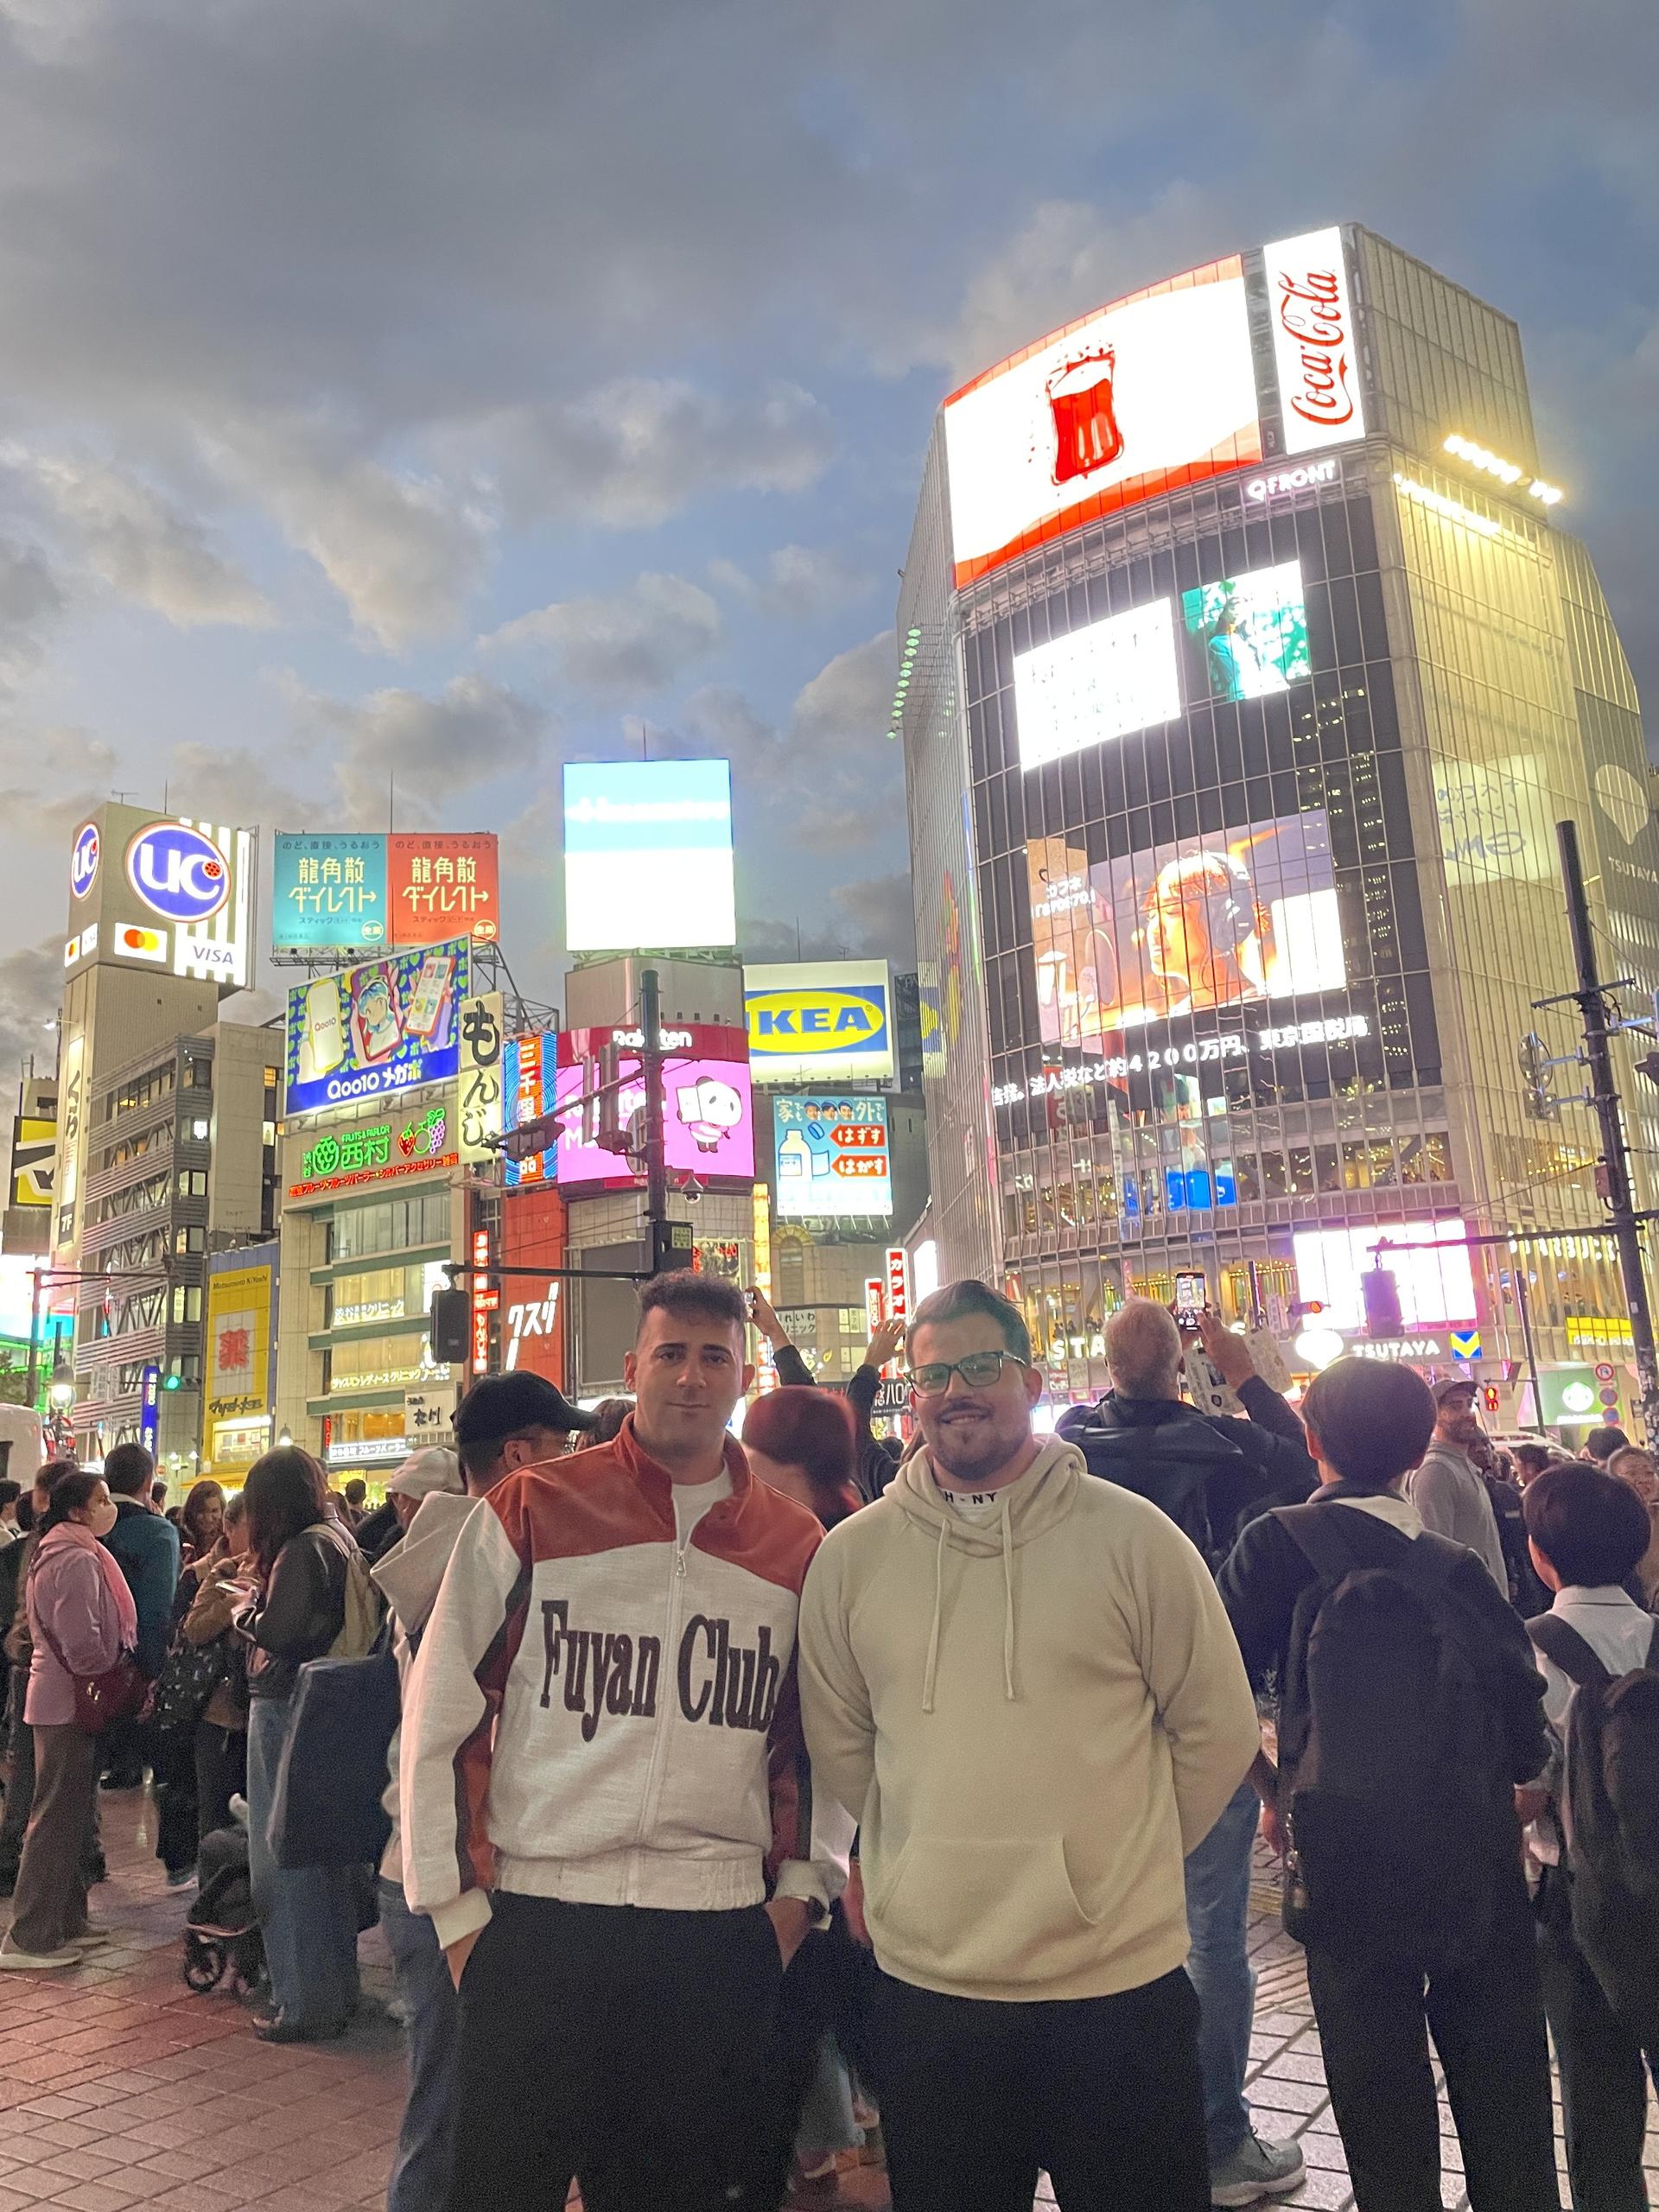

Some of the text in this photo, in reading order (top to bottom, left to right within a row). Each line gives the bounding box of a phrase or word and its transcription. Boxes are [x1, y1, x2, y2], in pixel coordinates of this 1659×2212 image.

[1278, 270, 1354, 426] Coca-Cola
[298, 856, 365, 884] 龍角散
[411, 856, 477, 883] 龍角散
[1608, 856, 1658, 884] TSUTAYA
[193, 945, 234, 965] VISA
[327, 1072, 380, 1100] Qoo10
[519, 1043, 537, 1174] 三千里品
[837, 1127, 881, 1145] はずす
[340, 1135, 390, 1171] 西村
[838, 1158, 883, 1175] はがす
[61, 1214, 73, 1232] 7F
[782, 1324, 816, 1333] リニック
[1352, 1340, 1441, 1359] TSUTAYA
[972, 1491, 998, 1504] NY
[540, 1599, 779, 1742] Fuyan Club
